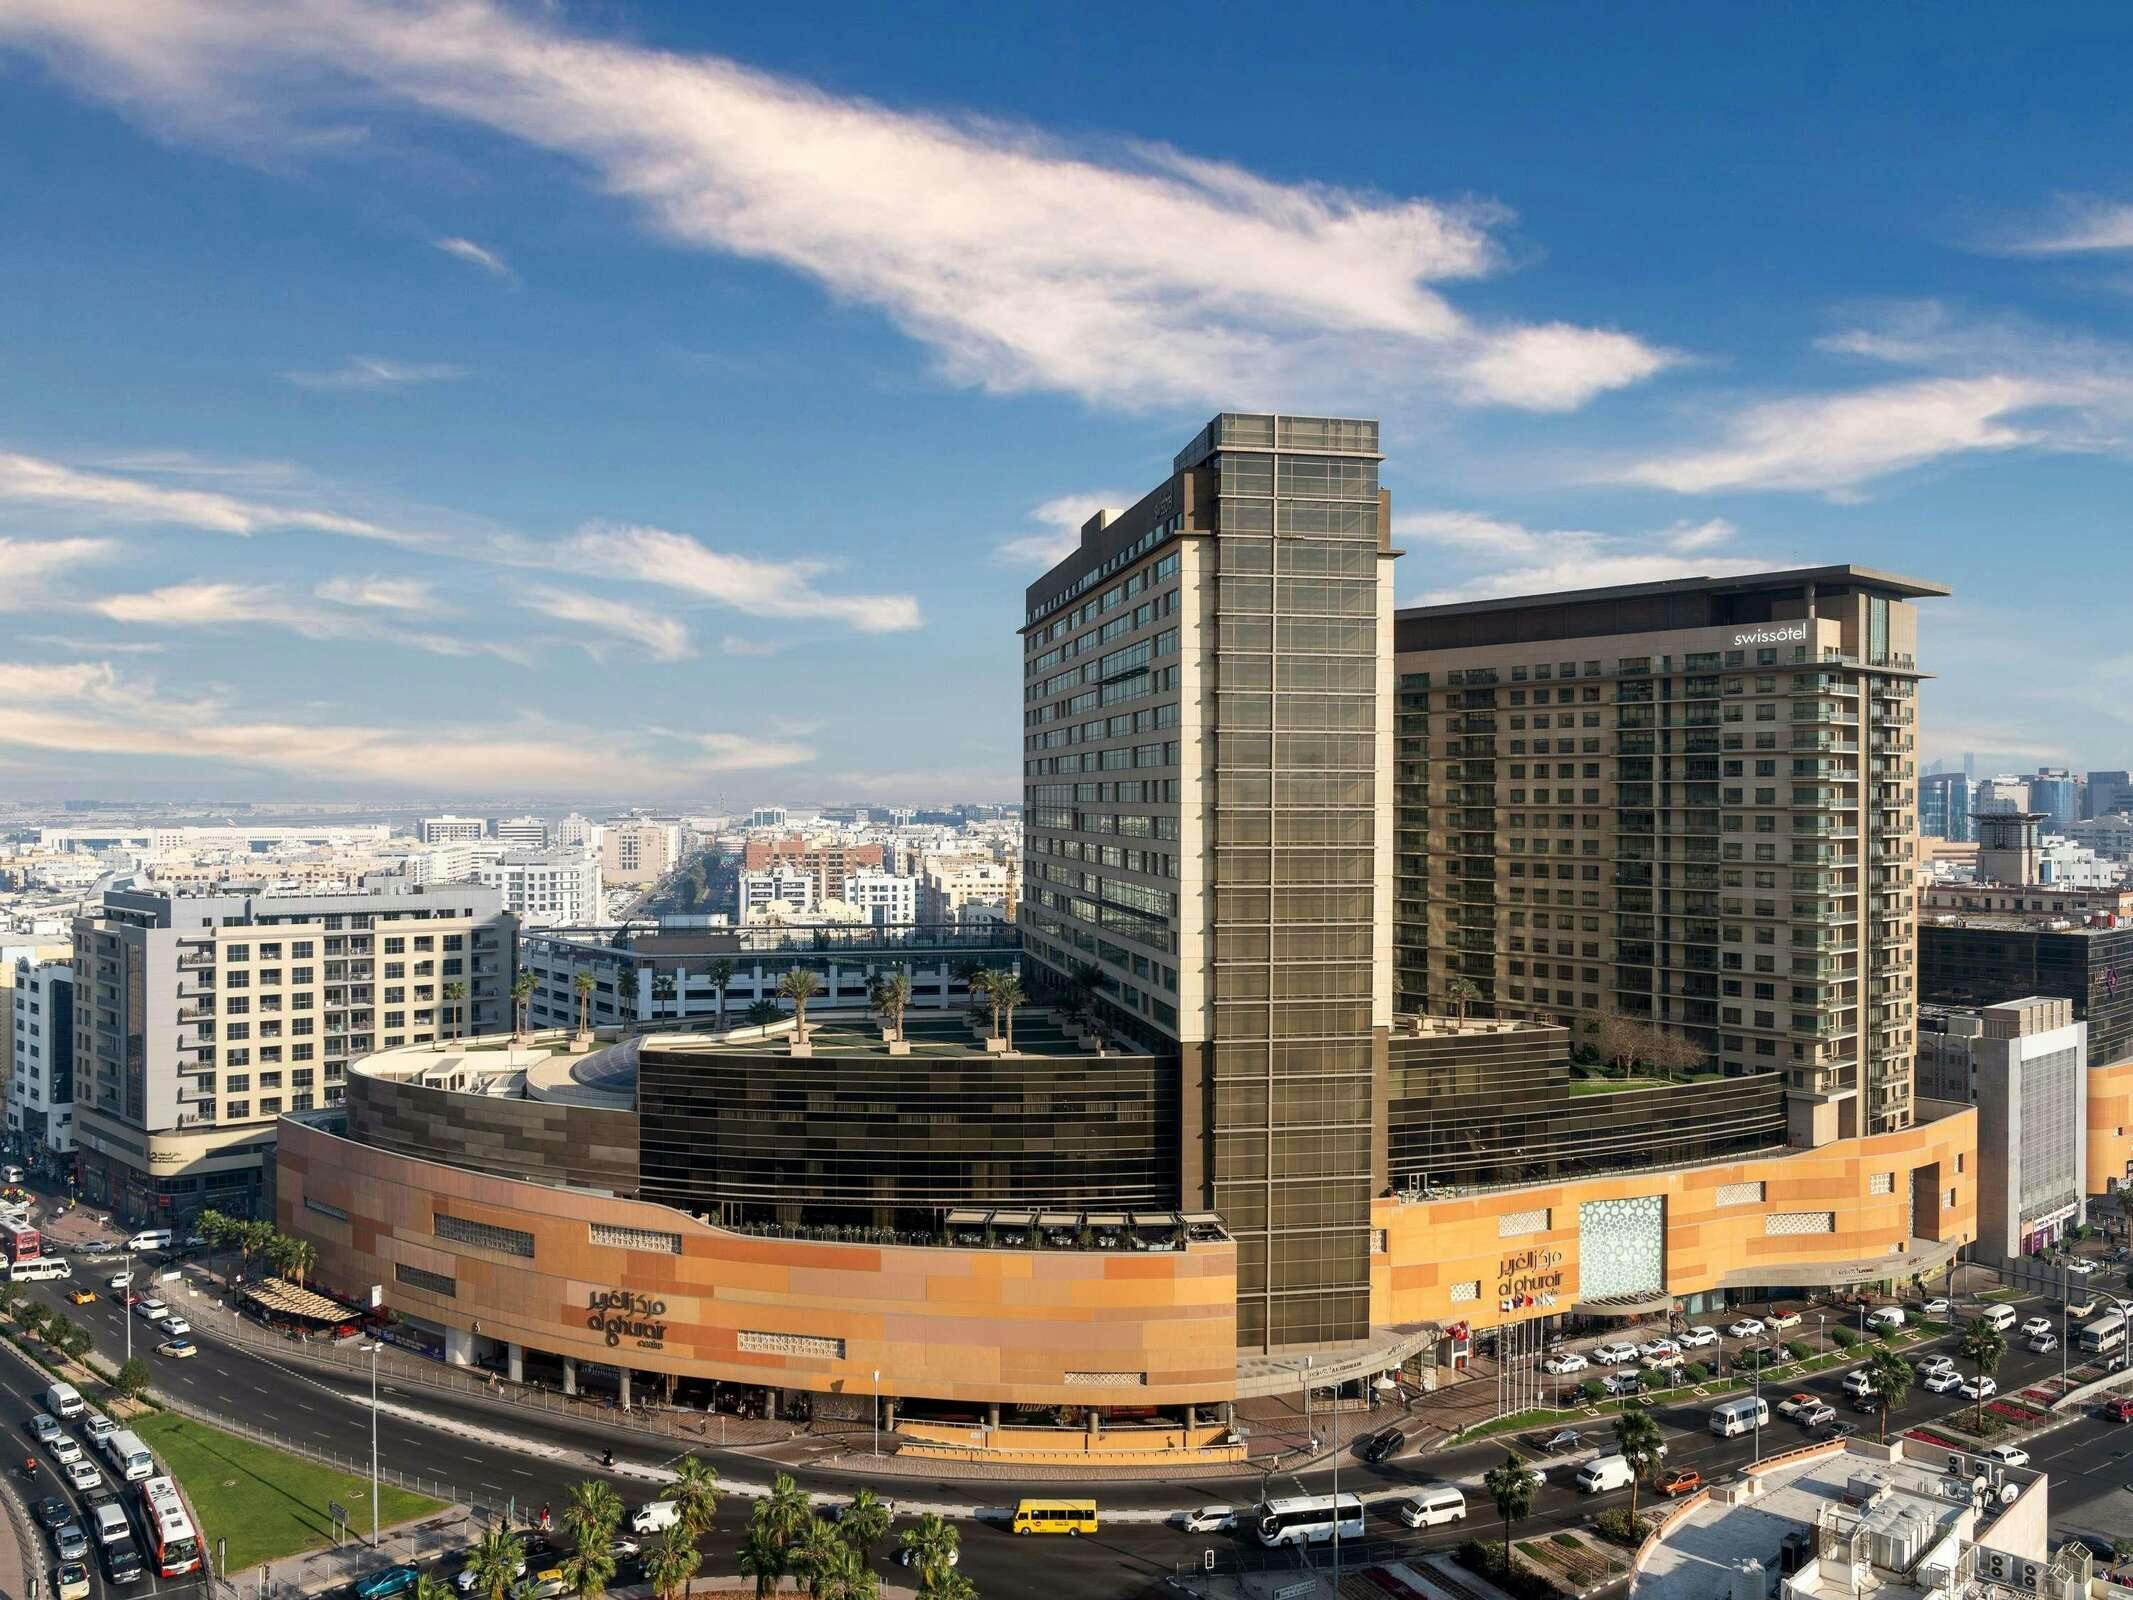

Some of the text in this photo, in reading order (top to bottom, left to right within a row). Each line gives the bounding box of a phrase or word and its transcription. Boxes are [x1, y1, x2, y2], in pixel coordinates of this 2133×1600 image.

[1734, 622, 1806, 646] swissôtel
[587, 1312, 667, 1347] al ghurair
